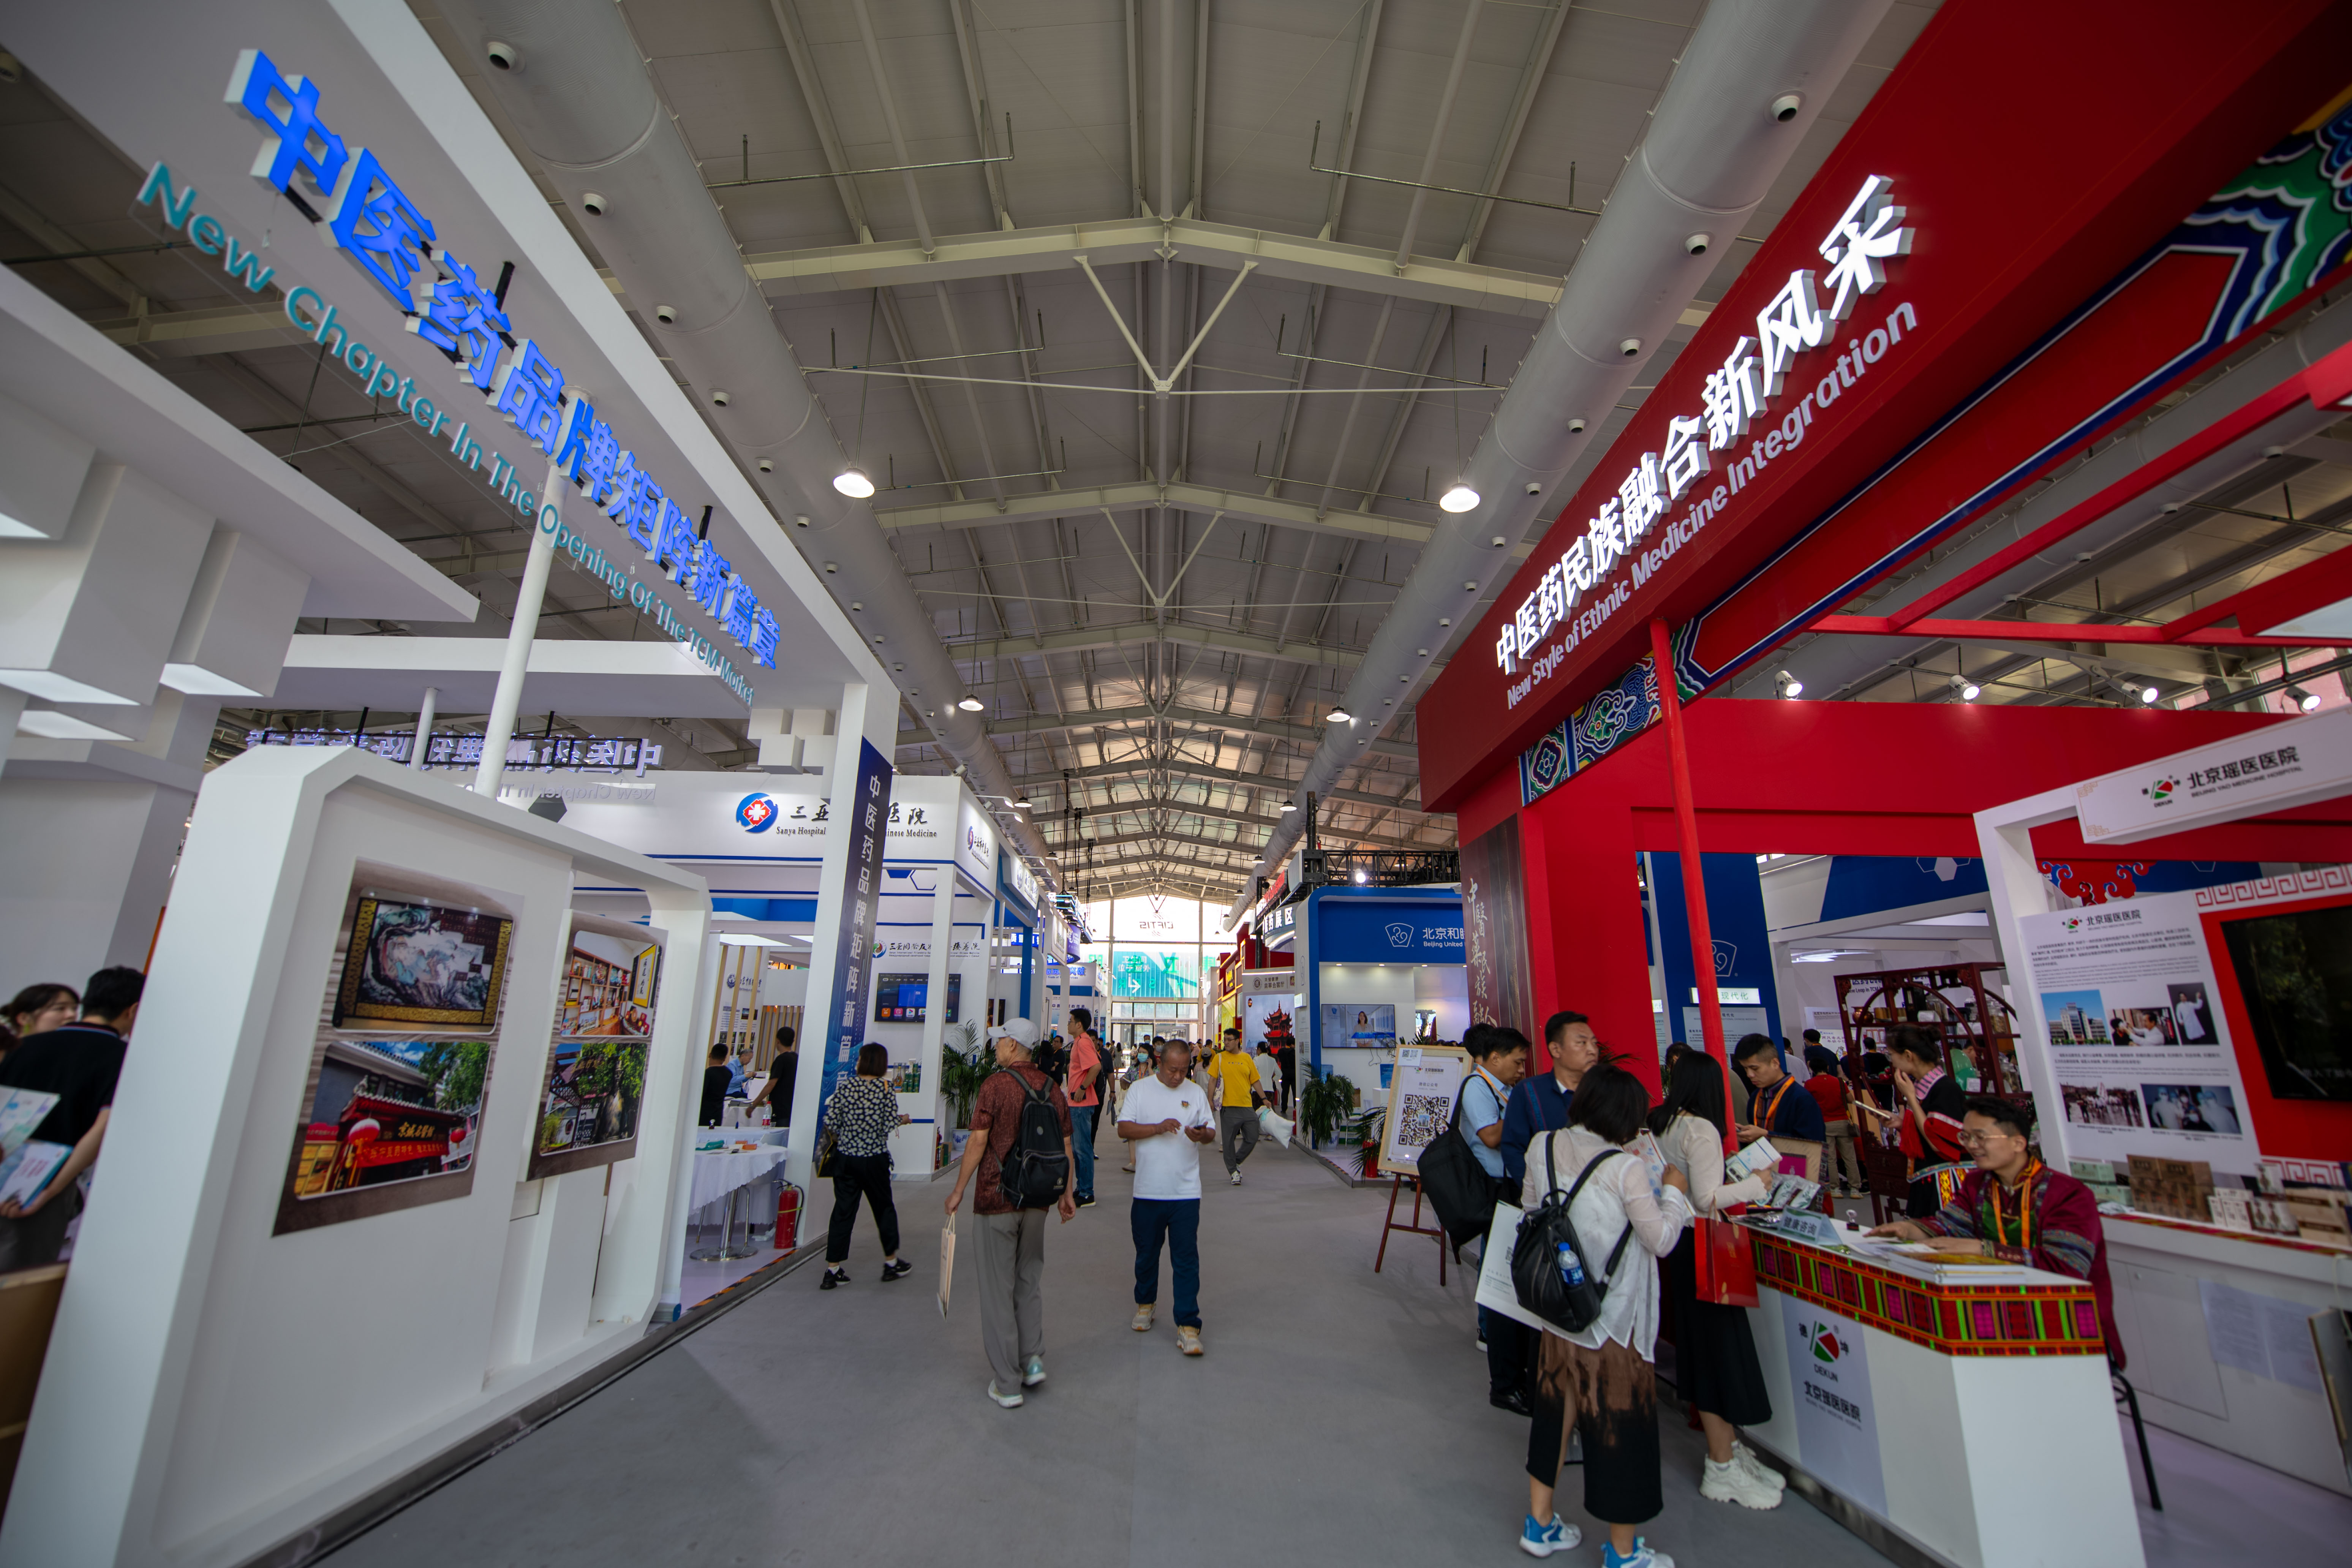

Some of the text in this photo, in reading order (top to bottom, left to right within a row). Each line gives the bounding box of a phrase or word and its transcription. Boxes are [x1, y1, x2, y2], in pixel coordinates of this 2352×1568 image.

[227, 49, 780, 670] 中医药品牌矩阵新篇章
[137, 160, 754, 703] New Chapter In The Opening Of The TCM Market
[1496, 174, 1911, 675] 中医药民族融合新风采
[1507, 302, 1917, 710] New Style of Ethnic Medicine Integration
[2187, 747, 2300, 789] 北京瑶医医院
[2232, 775, 2266, 788] MEDICINE
[2267, 766, 2303, 779] HOSPITAL
[776, 826, 795, 836] Sanya
[798, 827, 826, 836] Hospital
[790, 802, 928, 825] 三亚医院
[2086, 910, 2142, 926] 北京瑶医医院
